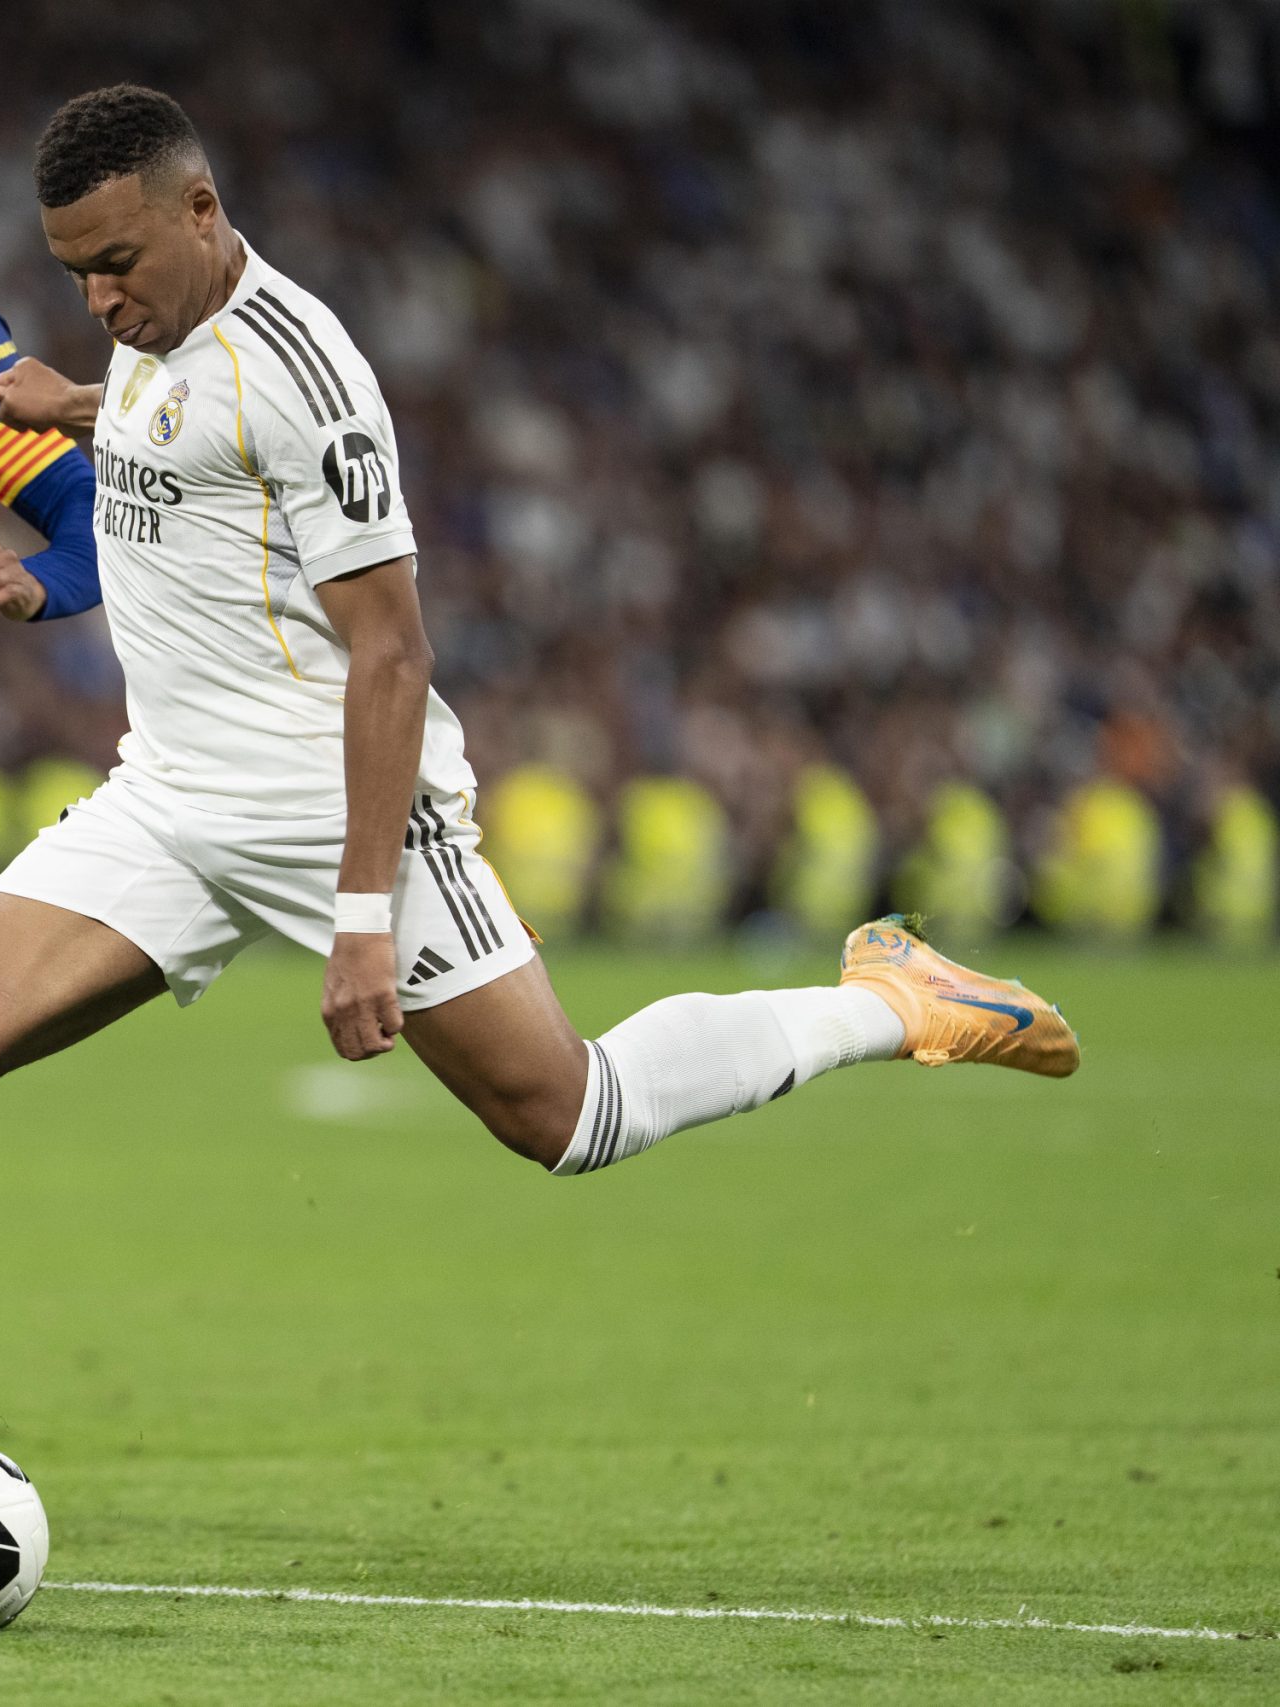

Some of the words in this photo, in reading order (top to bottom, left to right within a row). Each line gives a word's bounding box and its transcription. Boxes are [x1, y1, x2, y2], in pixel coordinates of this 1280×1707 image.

[95, 438, 183, 506] mirates
[331, 432, 387, 523] hp
[104, 497, 162, 544] BETTER
